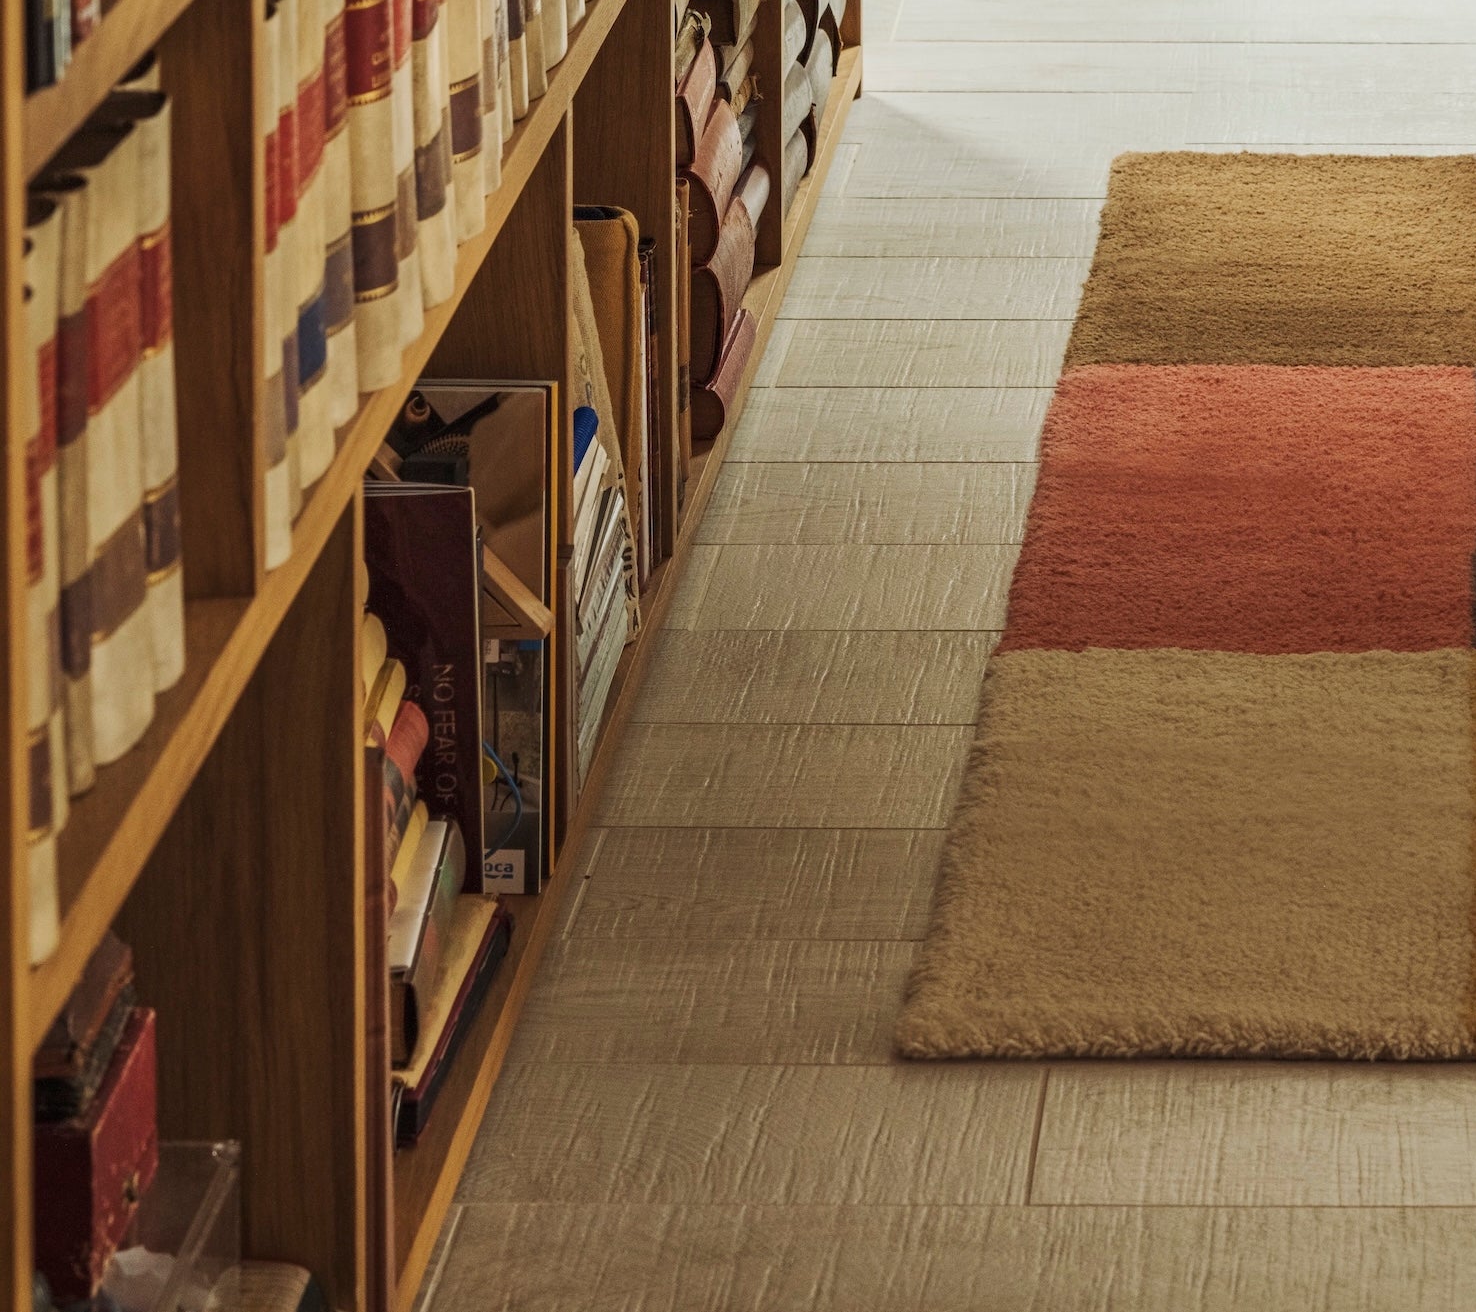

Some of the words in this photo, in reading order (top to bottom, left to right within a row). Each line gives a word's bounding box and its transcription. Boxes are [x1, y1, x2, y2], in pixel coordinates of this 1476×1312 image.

[432, 663, 454, 702] NO
[433, 711, 457, 767] FEAR
[435, 774, 458, 806] OF
[484, 861, 514, 874] oca
